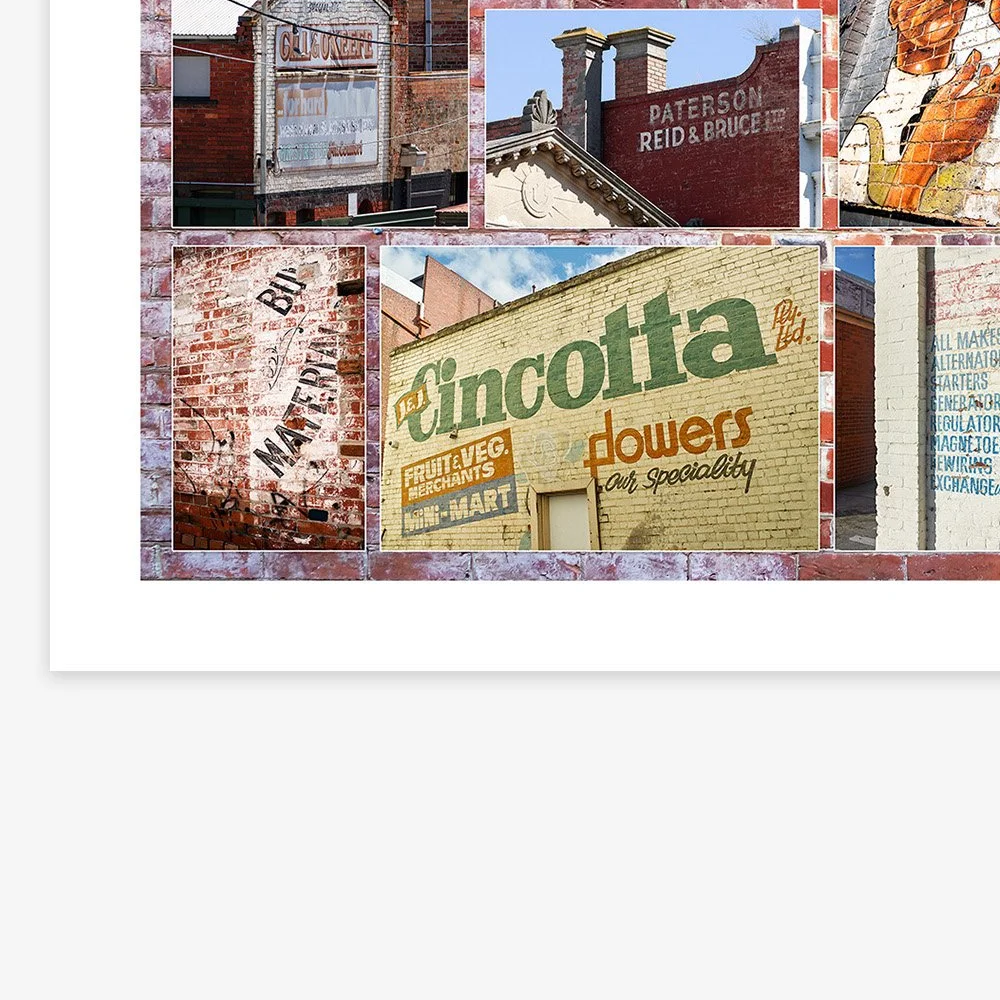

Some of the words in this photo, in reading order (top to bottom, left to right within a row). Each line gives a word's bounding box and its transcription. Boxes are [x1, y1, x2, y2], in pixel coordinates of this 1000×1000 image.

[649, 86, 762, 125] PATERSON
[639, 125, 685, 152] REID
[688, 126, 701, 144] &
[703, 111, 761, 142] BRUCE
[931, 333, 952, 353] ALL
[407, 292, 778, 443] Cincotta
[930, 371, 989, 392] STARTERS
[930, 454, 993, 475] REWIRING
[408, 461, 495, 501] MERCHANTS
[930, 473, 995, 496] EXCHANGE
